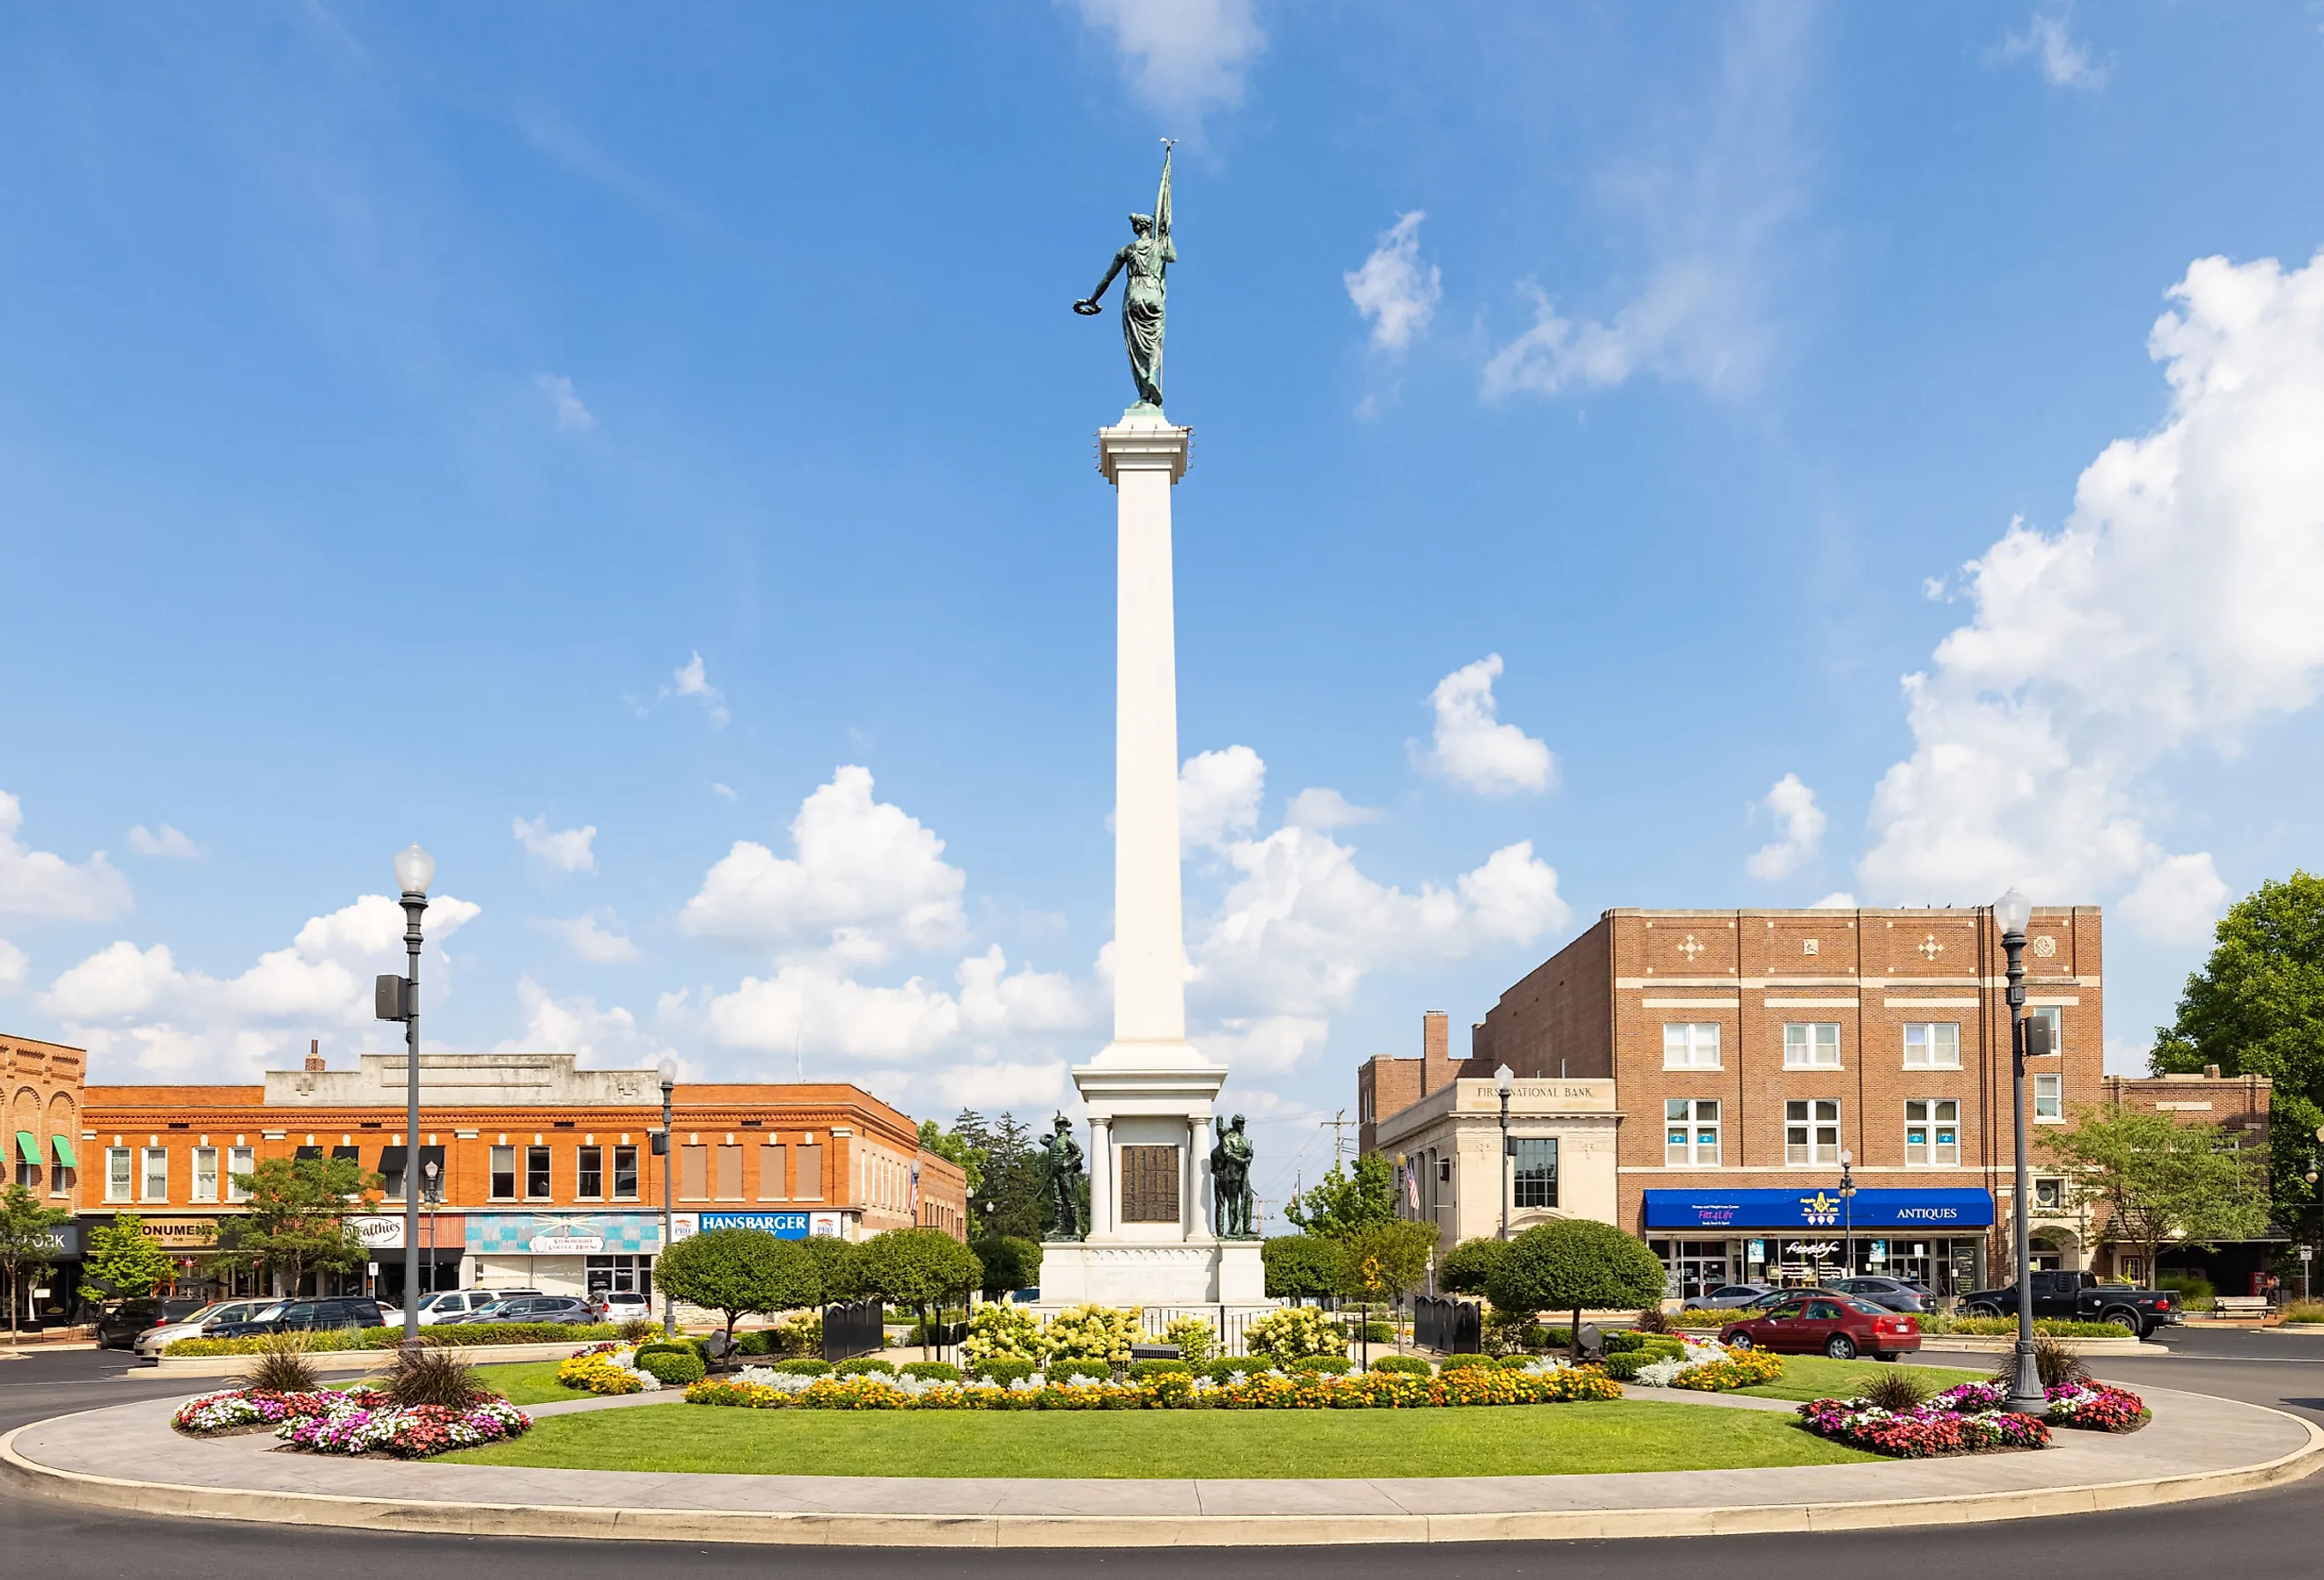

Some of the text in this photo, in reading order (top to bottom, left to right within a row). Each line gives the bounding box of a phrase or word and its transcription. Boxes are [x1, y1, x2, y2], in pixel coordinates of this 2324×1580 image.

[1477, 1087, 1500, 1098] FIRS
[1564, 1087, 1592, 1098] BANK
[1897, 1208, 1957, 1220] ANTIQUES
[703, 1216, 805, 1230] HANSBARGER
